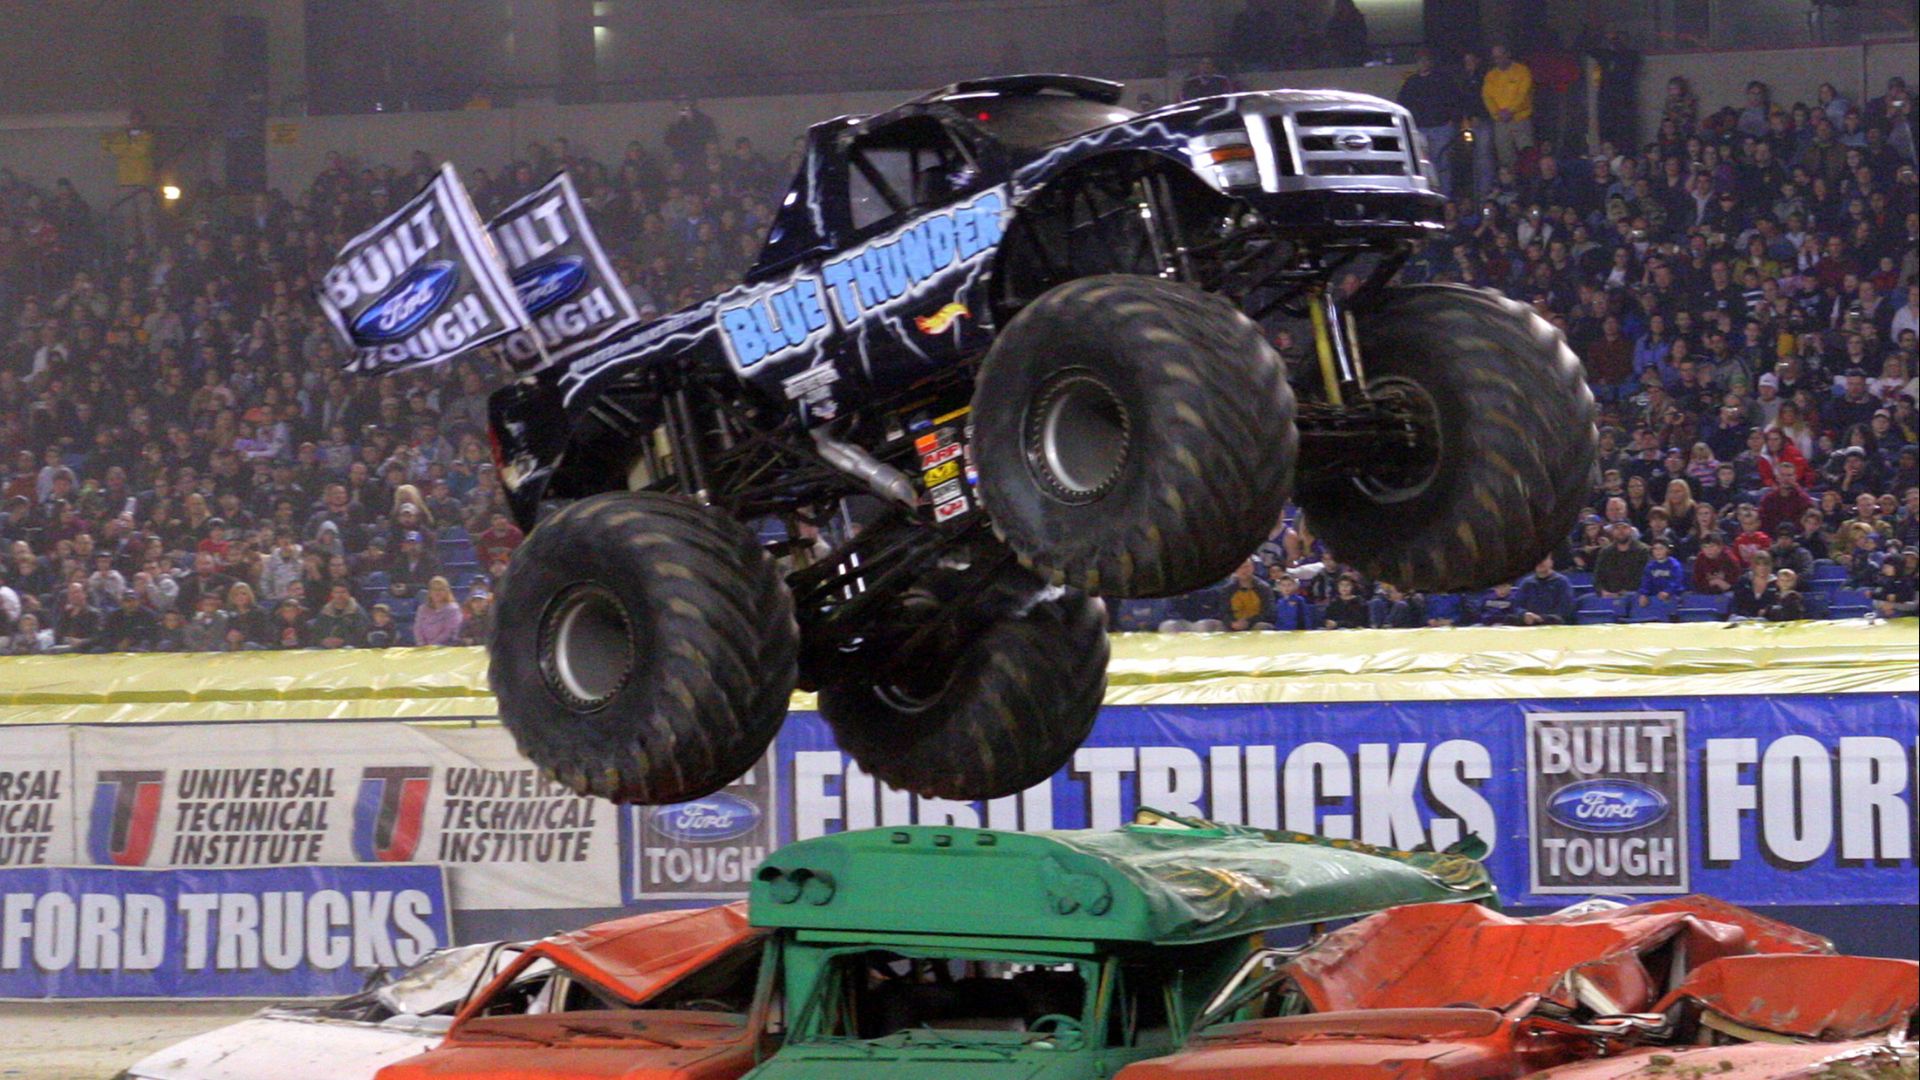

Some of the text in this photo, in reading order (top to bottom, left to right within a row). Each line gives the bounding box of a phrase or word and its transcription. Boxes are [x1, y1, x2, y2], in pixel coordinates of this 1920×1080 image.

[499, 195, 569, 269] ILT
[324, 202, 440, 309] BUILT
[718, 278, 828, 368] BLUE
[822, 191, 1006, 325] THUNDER
[378, 283, 437, 330] Ford
[505, 286, 616, 361] OUGH
[361, 293, 491, 369] TOUGH
[1540, 725, 1672, 774] BUILT
[177, 768, 335, 799] UNIVERSAL
[446, 767, 577, 797] UNIVER
[1073, 739, 1497, 861] TRUCKS
[1706, 734, 1919, 862] FOR
[174, 801, 329, 832] TECHNICAL
[442, 798, 597, 831] TECHNICAL
[676, 803, 733, 828] Ford
[1575, 791, 1639, 818] Ford
[170, 834, 325, 865] INSTITUTE
[438, 831, 591, 863] INSTITUTE
[645, 847, 766, 884] TOUGH
[1542, 837, 1675, 877] TOUGH
[2, 889, 438, 970] FORD TRUCKS
